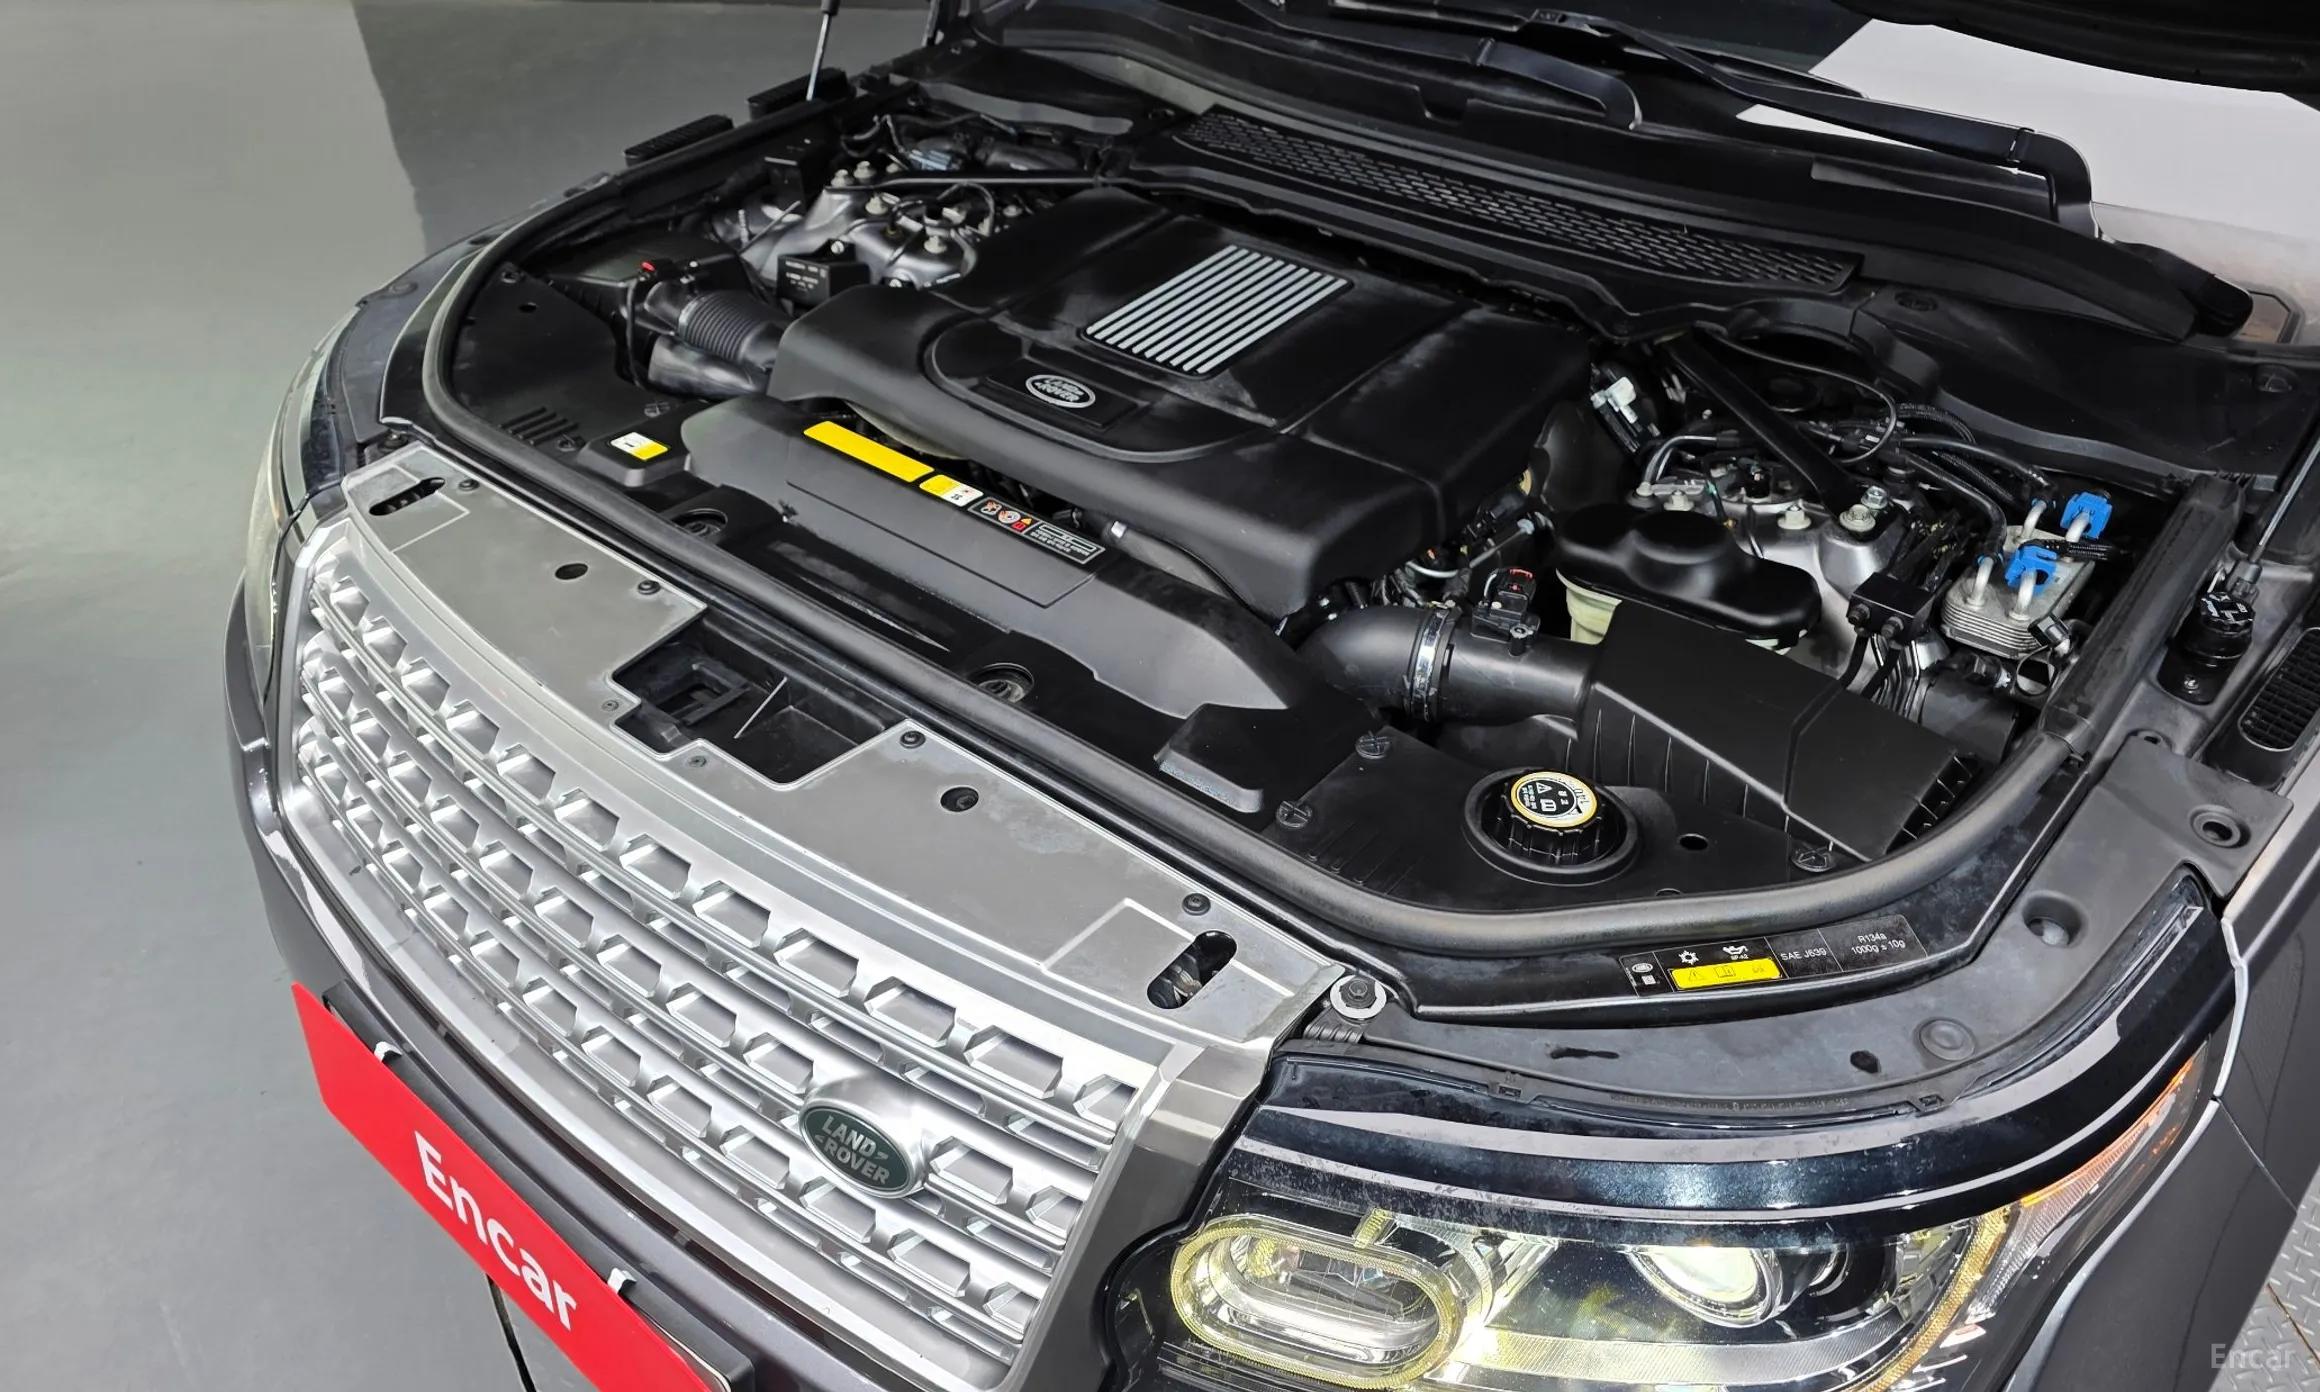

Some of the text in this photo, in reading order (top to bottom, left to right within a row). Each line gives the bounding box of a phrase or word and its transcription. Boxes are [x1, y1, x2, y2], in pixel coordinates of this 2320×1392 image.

[1037, 383, 1080, 402] ROVER
[1850, 943, 1880, 956] 1000g
[1887, 939, 1906, 949] 10g
[1857, 932, 1887, 944] R134a
[1780, 947, 1827, 961] SAE J639
[821, 1115, 877, 1157] LAND
[823, 1136, 890, 1185] ROVER
[415, 1130, 578, 1332] Encar
